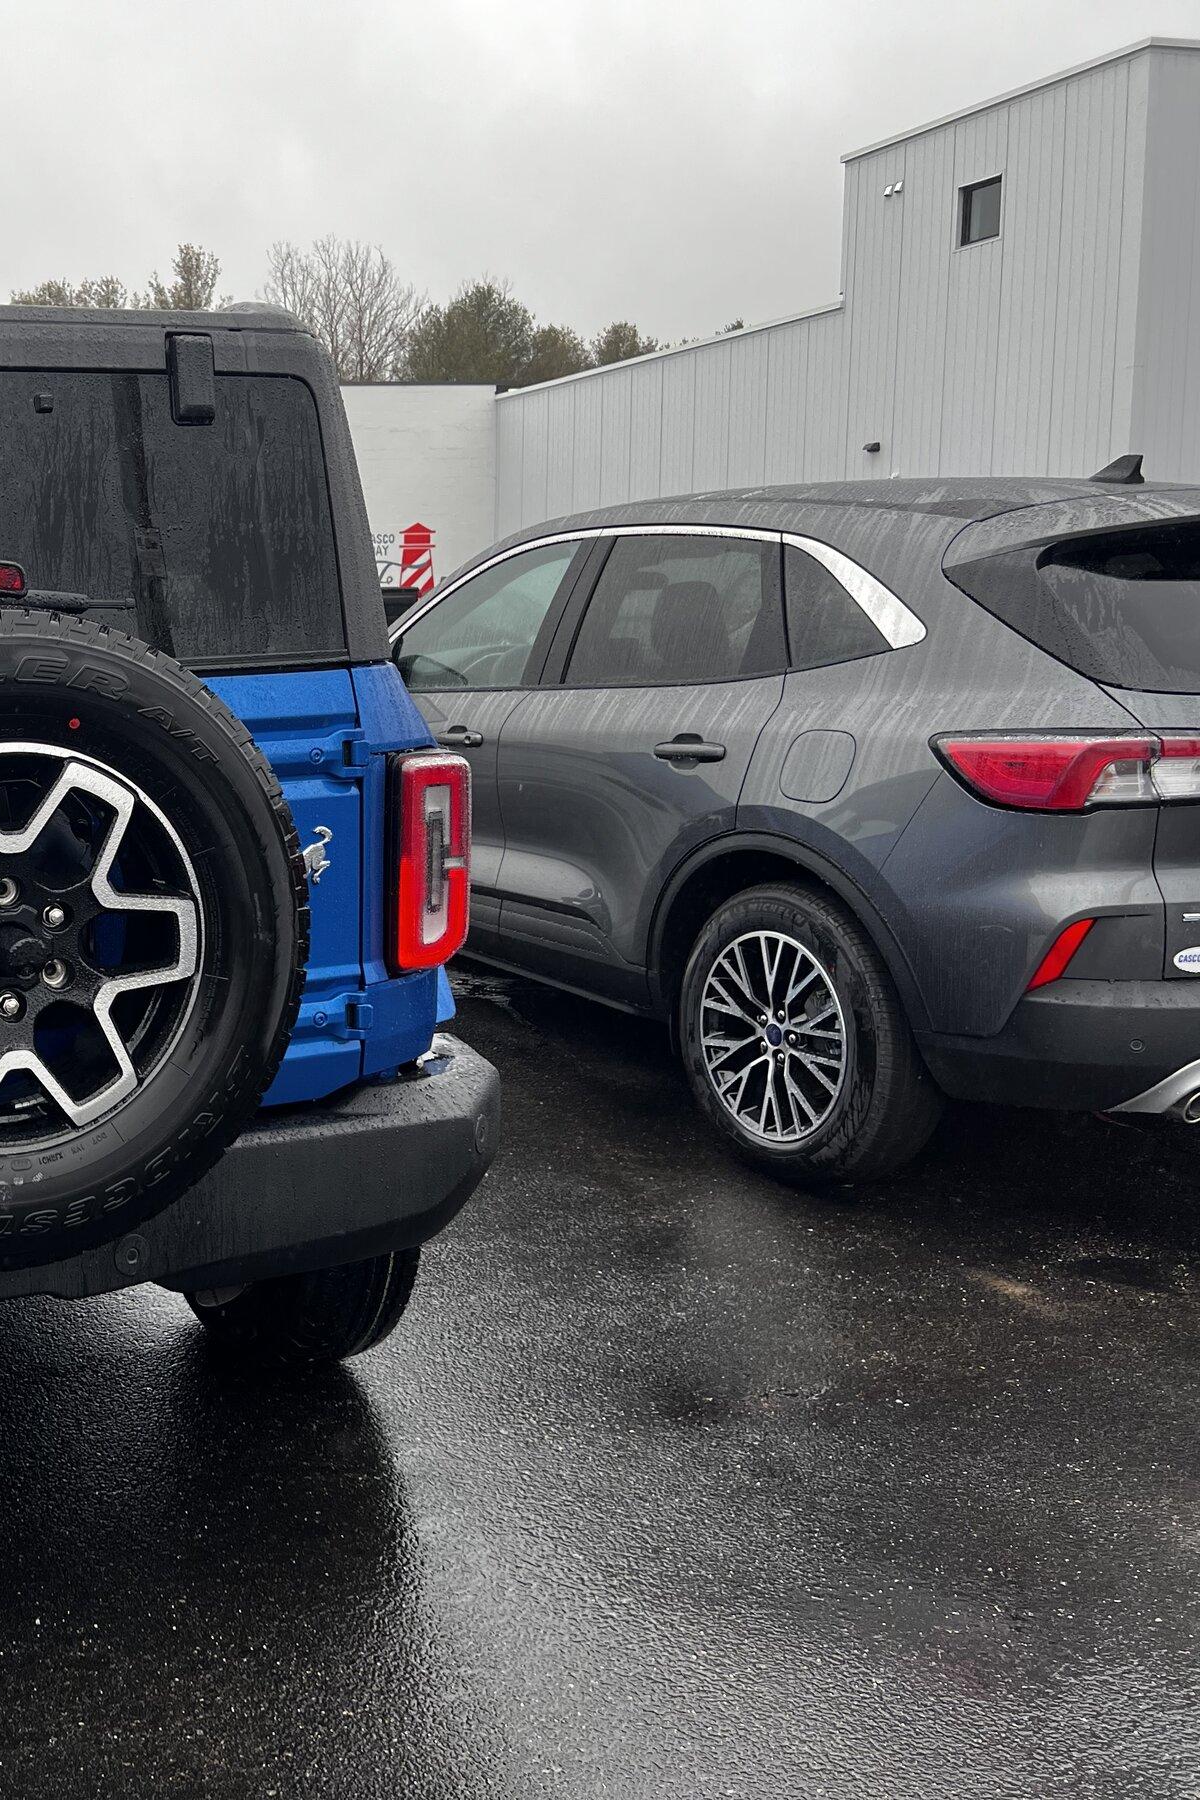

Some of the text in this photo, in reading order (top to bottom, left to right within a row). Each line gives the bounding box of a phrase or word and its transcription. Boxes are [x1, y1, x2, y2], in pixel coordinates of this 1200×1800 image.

[371, 534, 395, 544] ASCO
[376, 545, 389, 556] AY
[137, 704, 221, 767] A/T
